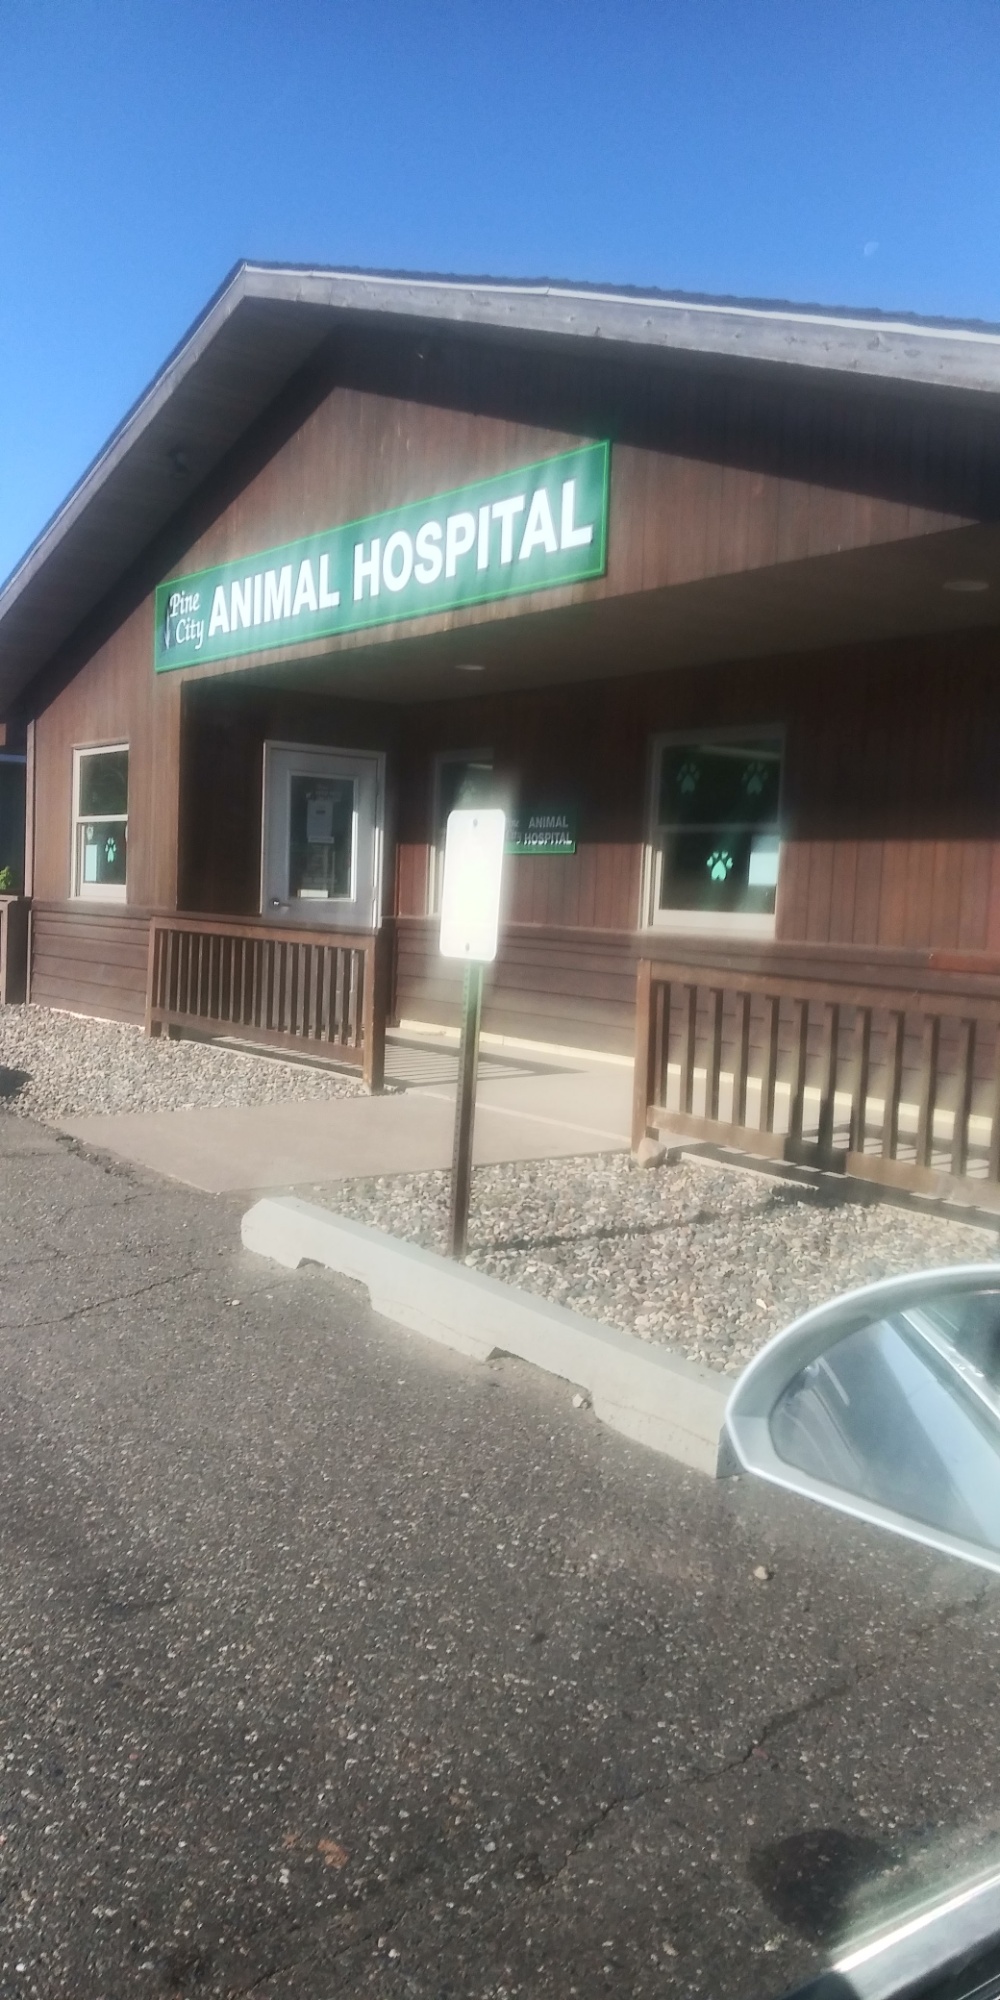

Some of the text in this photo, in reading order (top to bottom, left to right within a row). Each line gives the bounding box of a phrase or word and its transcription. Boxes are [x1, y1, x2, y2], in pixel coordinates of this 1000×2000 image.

[208, 479, 594, 637] ANIMAL HOSPITAL
[169, 590, 201, 617] Pine
[175, 616, 204, 650] City
[528, 815, 568, 829] ANIMAL
[524, 831, 573, 846] HOSPITAL
